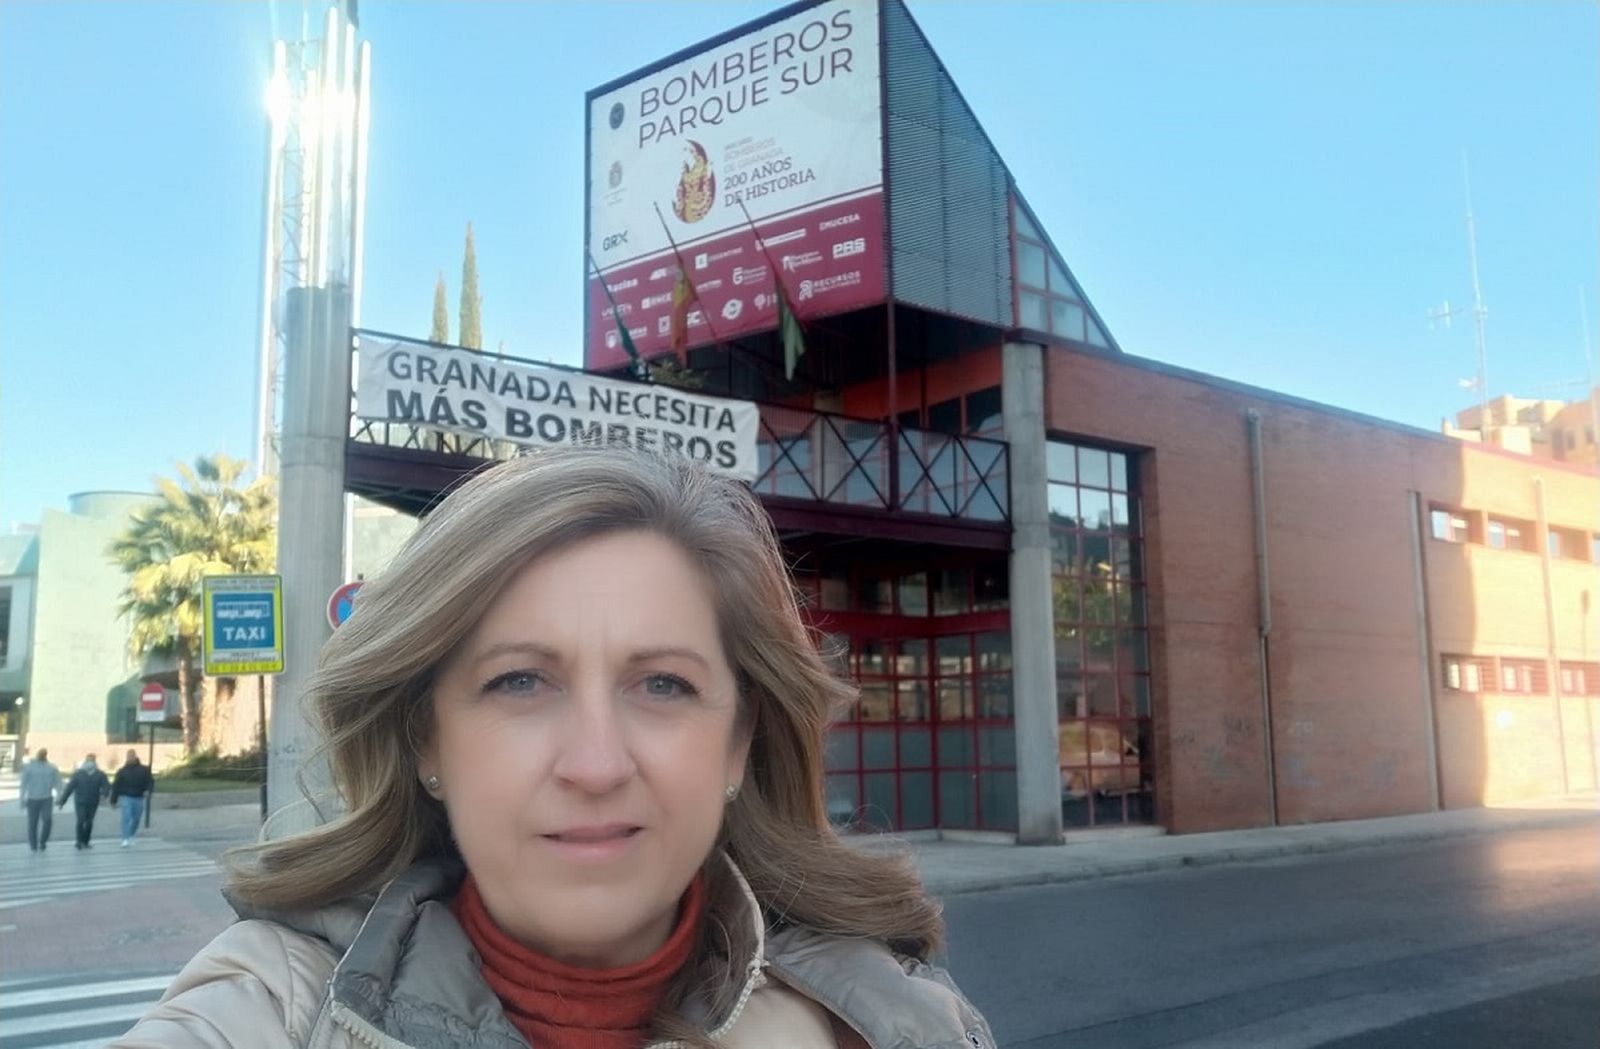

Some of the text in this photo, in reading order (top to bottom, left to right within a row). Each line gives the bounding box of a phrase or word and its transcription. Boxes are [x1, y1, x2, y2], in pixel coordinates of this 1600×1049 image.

[639, 47, 853, 148] PARQUE SUR
[640, 9, 853, 117] BOMBEROS
[724, 156, 793, 191] 200 AÑOS
[724, 168, 816, 207] DE HISTORIA
[386, 387, 737, 469] MÁS BOMBEROS
[387, 351, 736, 433] GRANADA NECESITA
[222, 626, 266, 641] TAXI
